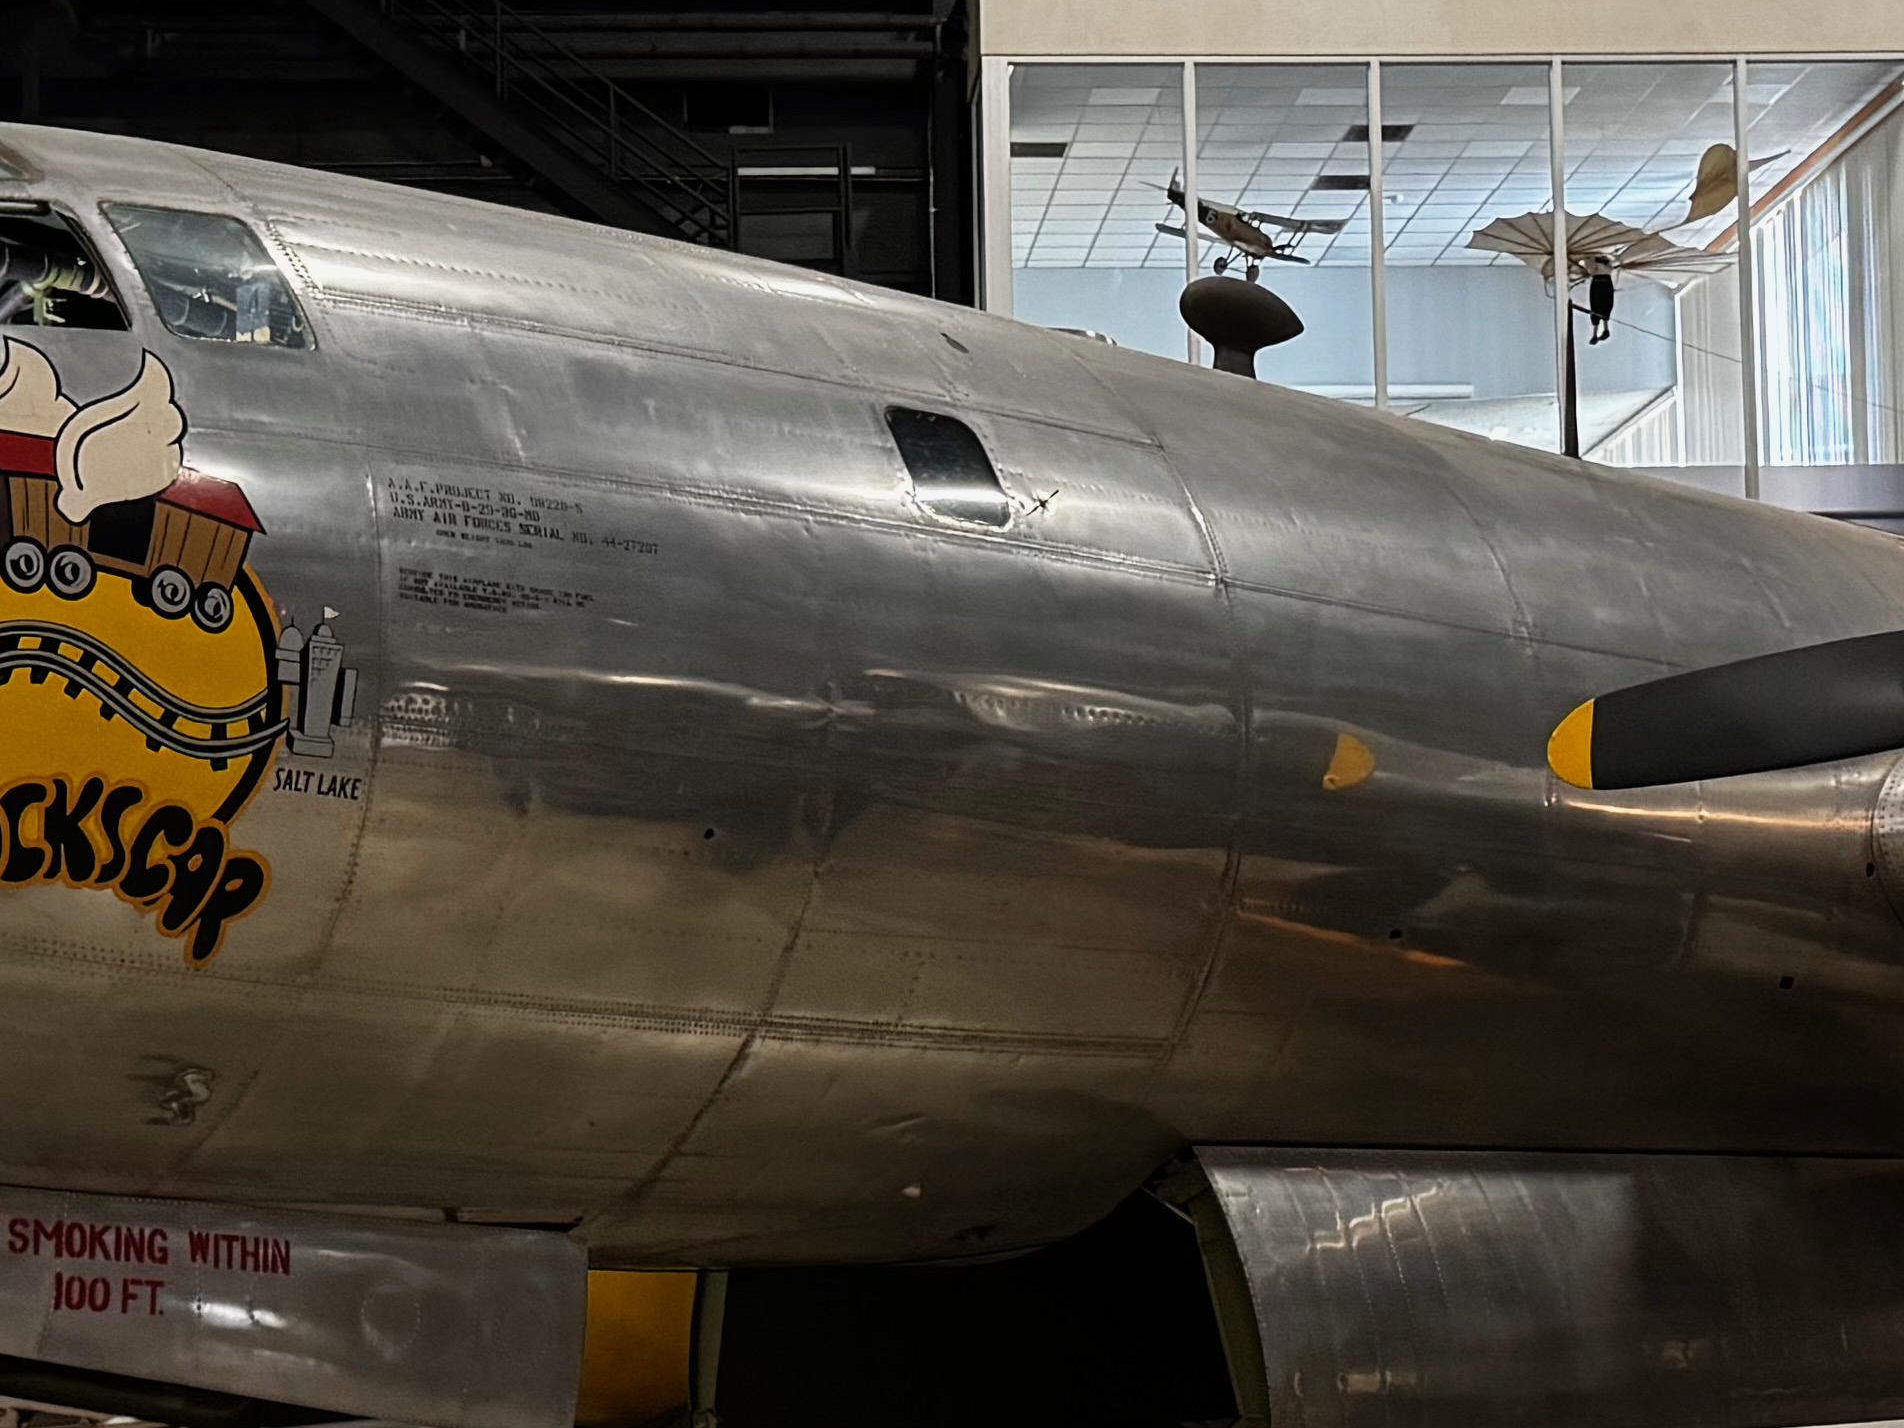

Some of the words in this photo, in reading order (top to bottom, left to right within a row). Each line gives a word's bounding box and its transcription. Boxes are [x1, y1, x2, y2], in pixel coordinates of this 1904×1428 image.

[393, 505, 424, 521] ARMY
[433, 511, 458, 526] AIR
[463, 515, 512, 533] FORCES
[518, 522, 565, 541] SERIAL
[273, 767, 315, 793] SALT
[317, 773, 362, 801] LAKE
[8, 1217, 169, 1265] SMOKING
[188, 1229, 291, 1276] WITHIN
[53, 1272, 111, 1312] 100
[120, 1278, 165, 1316] FT.
